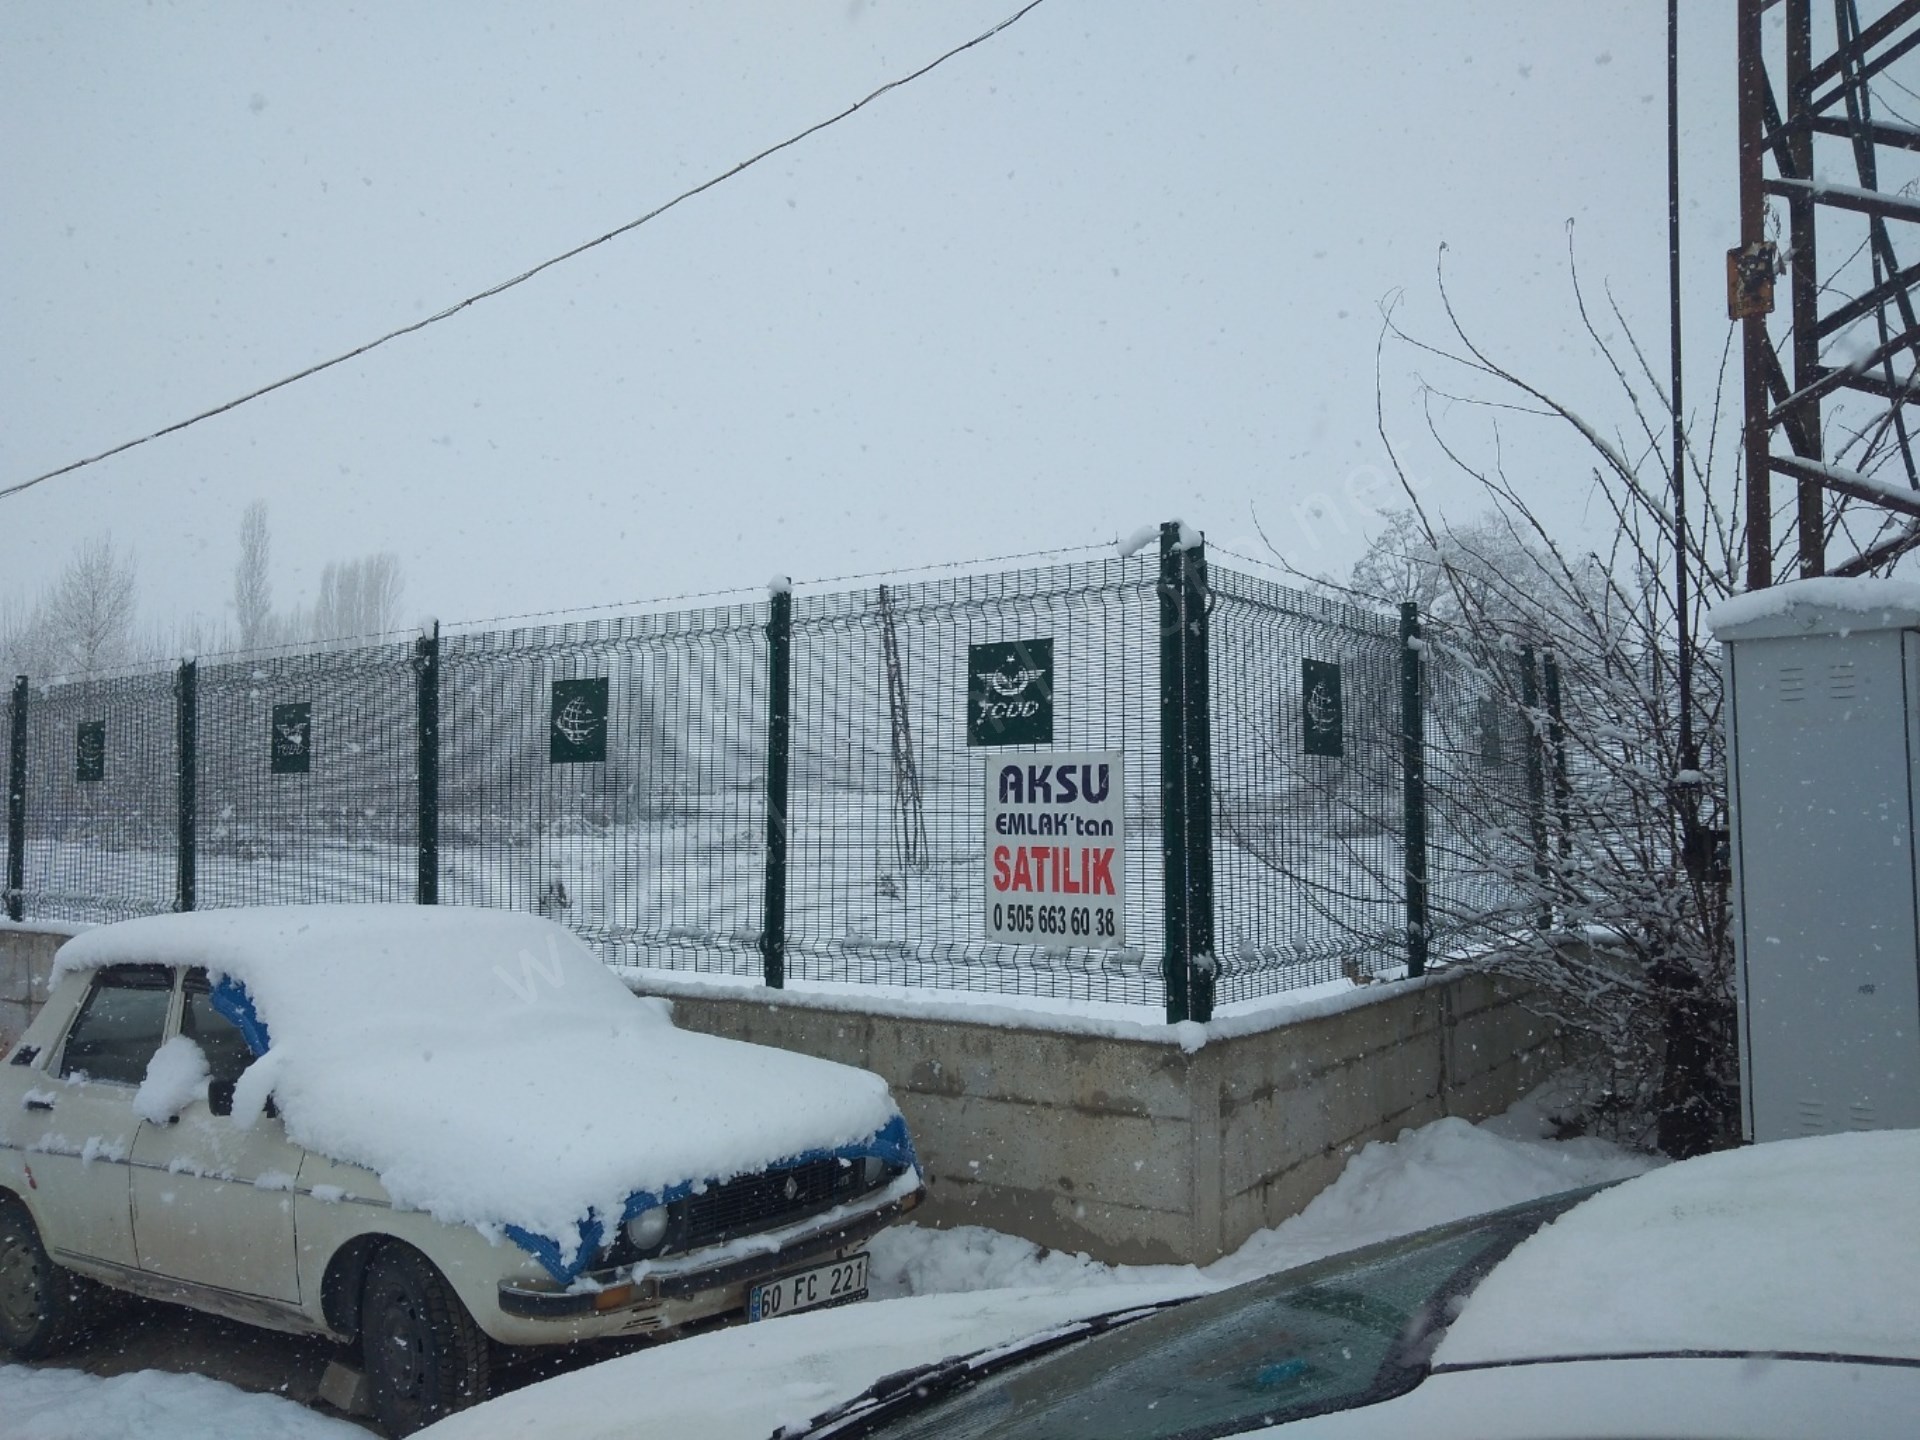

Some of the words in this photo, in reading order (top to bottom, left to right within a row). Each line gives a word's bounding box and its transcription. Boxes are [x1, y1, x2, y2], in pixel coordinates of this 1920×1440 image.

[979, 701, 1039, 719] TCDD
[999, 764, 1109, 804] AKSU
[995, 813, 1114, 836] EMLAK'tan
[993, 845, 1116, 895] SATILIK
[994, 903, 1002, 932] 0
[1007, 904, 1034, 933] 505
[1038, 905, 1066, 935] 663
[1071, 907, 1090, 936] 60
[1095, 908, 1115, 937] 38
[762, 1285, 782, 1317] 60
[794, 1274, 817, 1306] FC
[830, 1261, 862, 1295] 221
